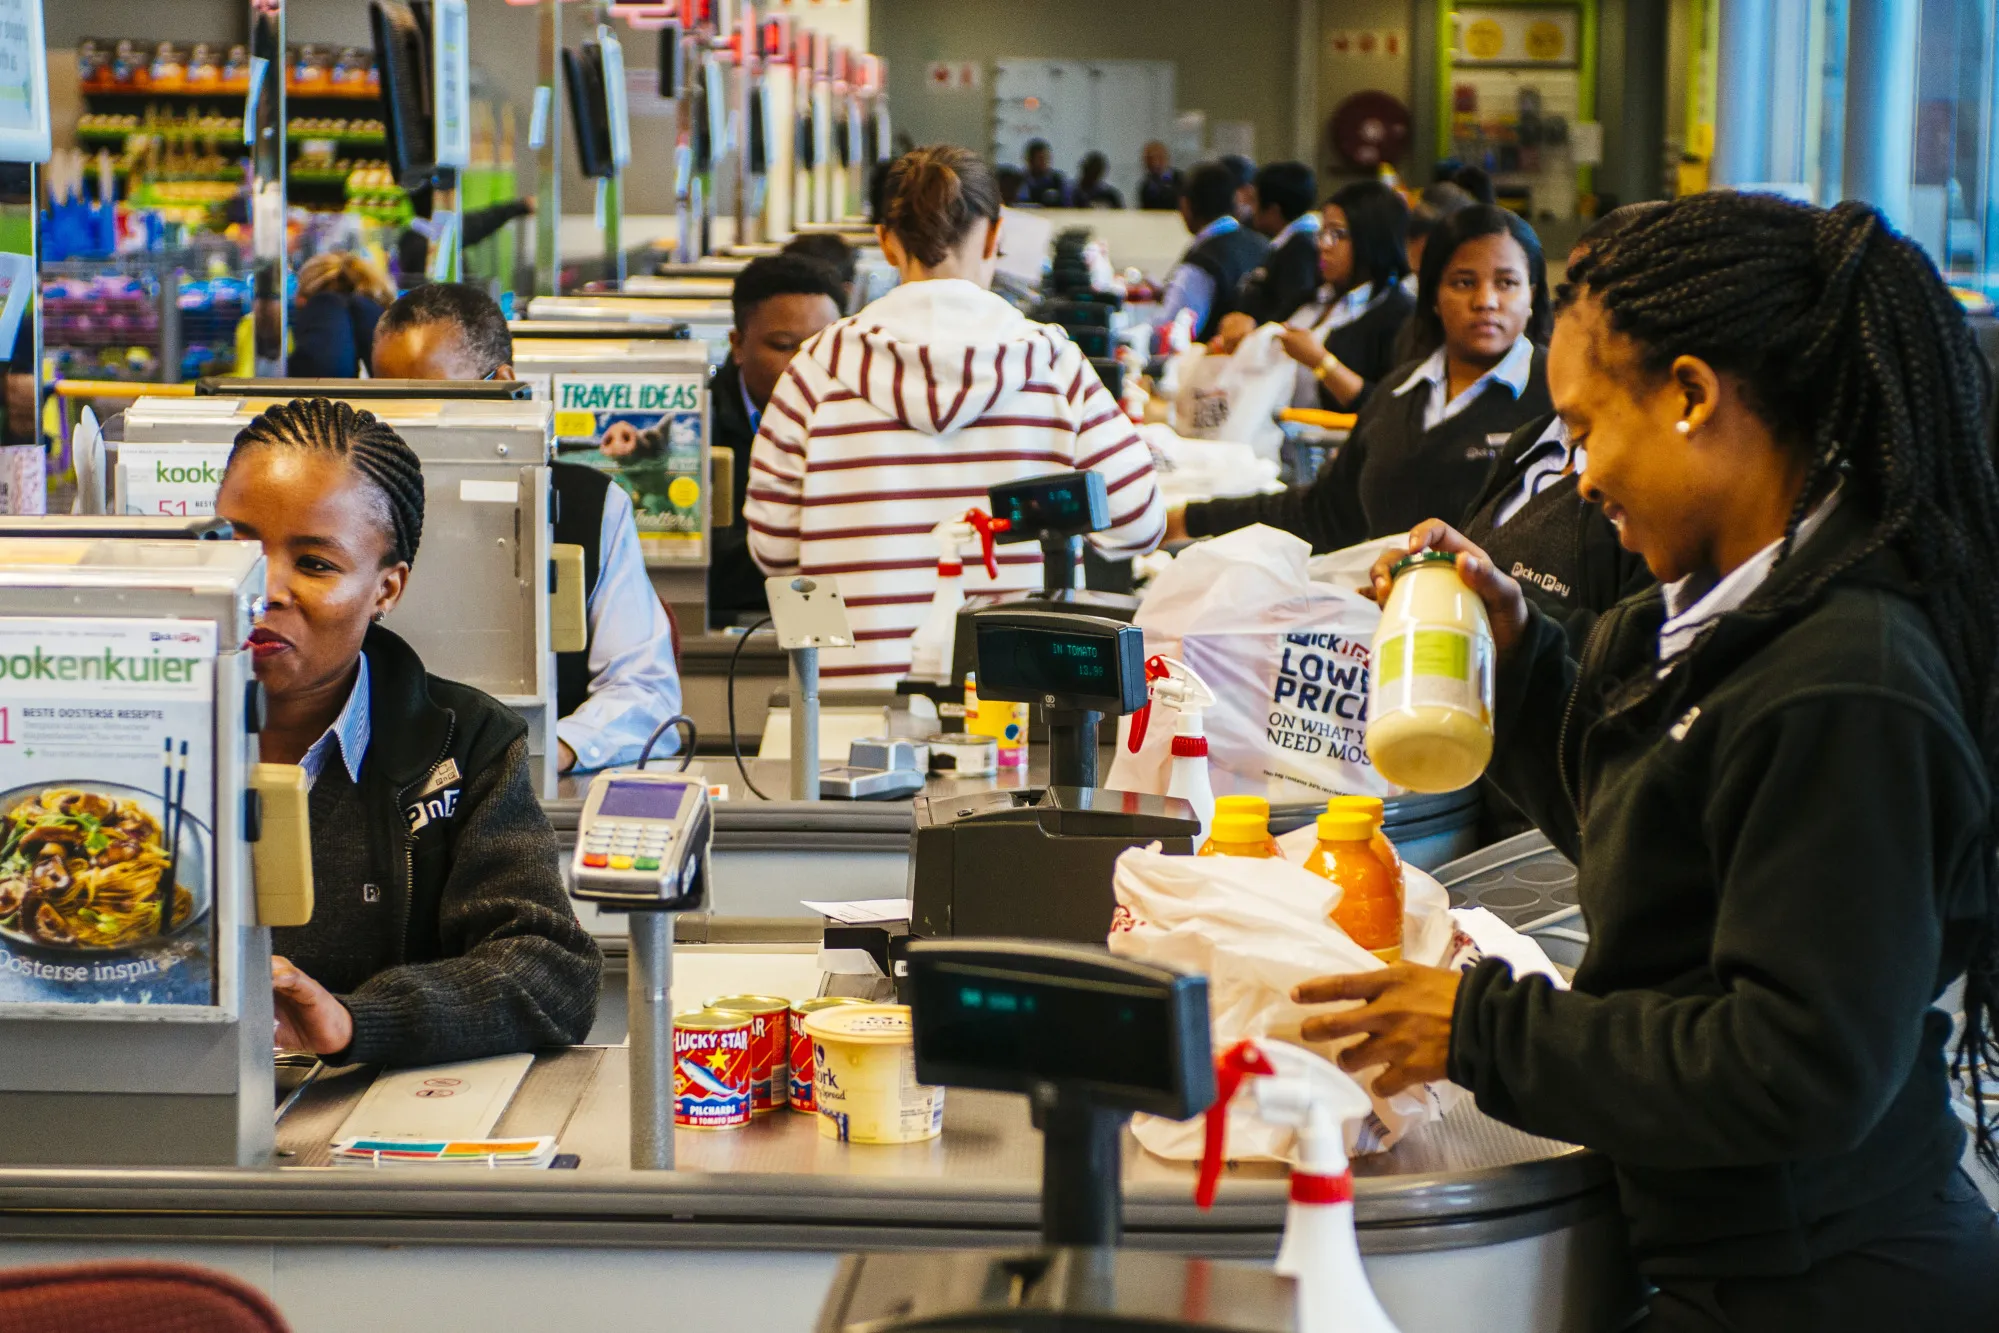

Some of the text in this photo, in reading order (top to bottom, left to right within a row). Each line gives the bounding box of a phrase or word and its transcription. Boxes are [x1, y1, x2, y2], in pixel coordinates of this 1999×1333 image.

[561, 382, 698, 409] TRAVEL IDEAS
[1511, 561, 1535, 582] Pick
[1541, 573, 1571, 597] Pay
[1052, 643, 1098, 658] IN TOMATO
[0, 646, 200, 682] okenkuier
[23, 708, 54, 717] BESTE
[58, 708, 114, 719] OOSTERSE
[117, 709, 164, 719] RESEPTE
[1268, 711, 1297, 730] ON
[1301, 717, 1354, 742] WHAT
[1266, 728, 1322, 754] NEED
[675, 1030, 748, 1053] LUCKY STAR
[689, 1104, 736, 1117] PILCHARDS
[689, 1116, 698, 1125] IN
[698, 1116, 727, 1126] TOMATO
